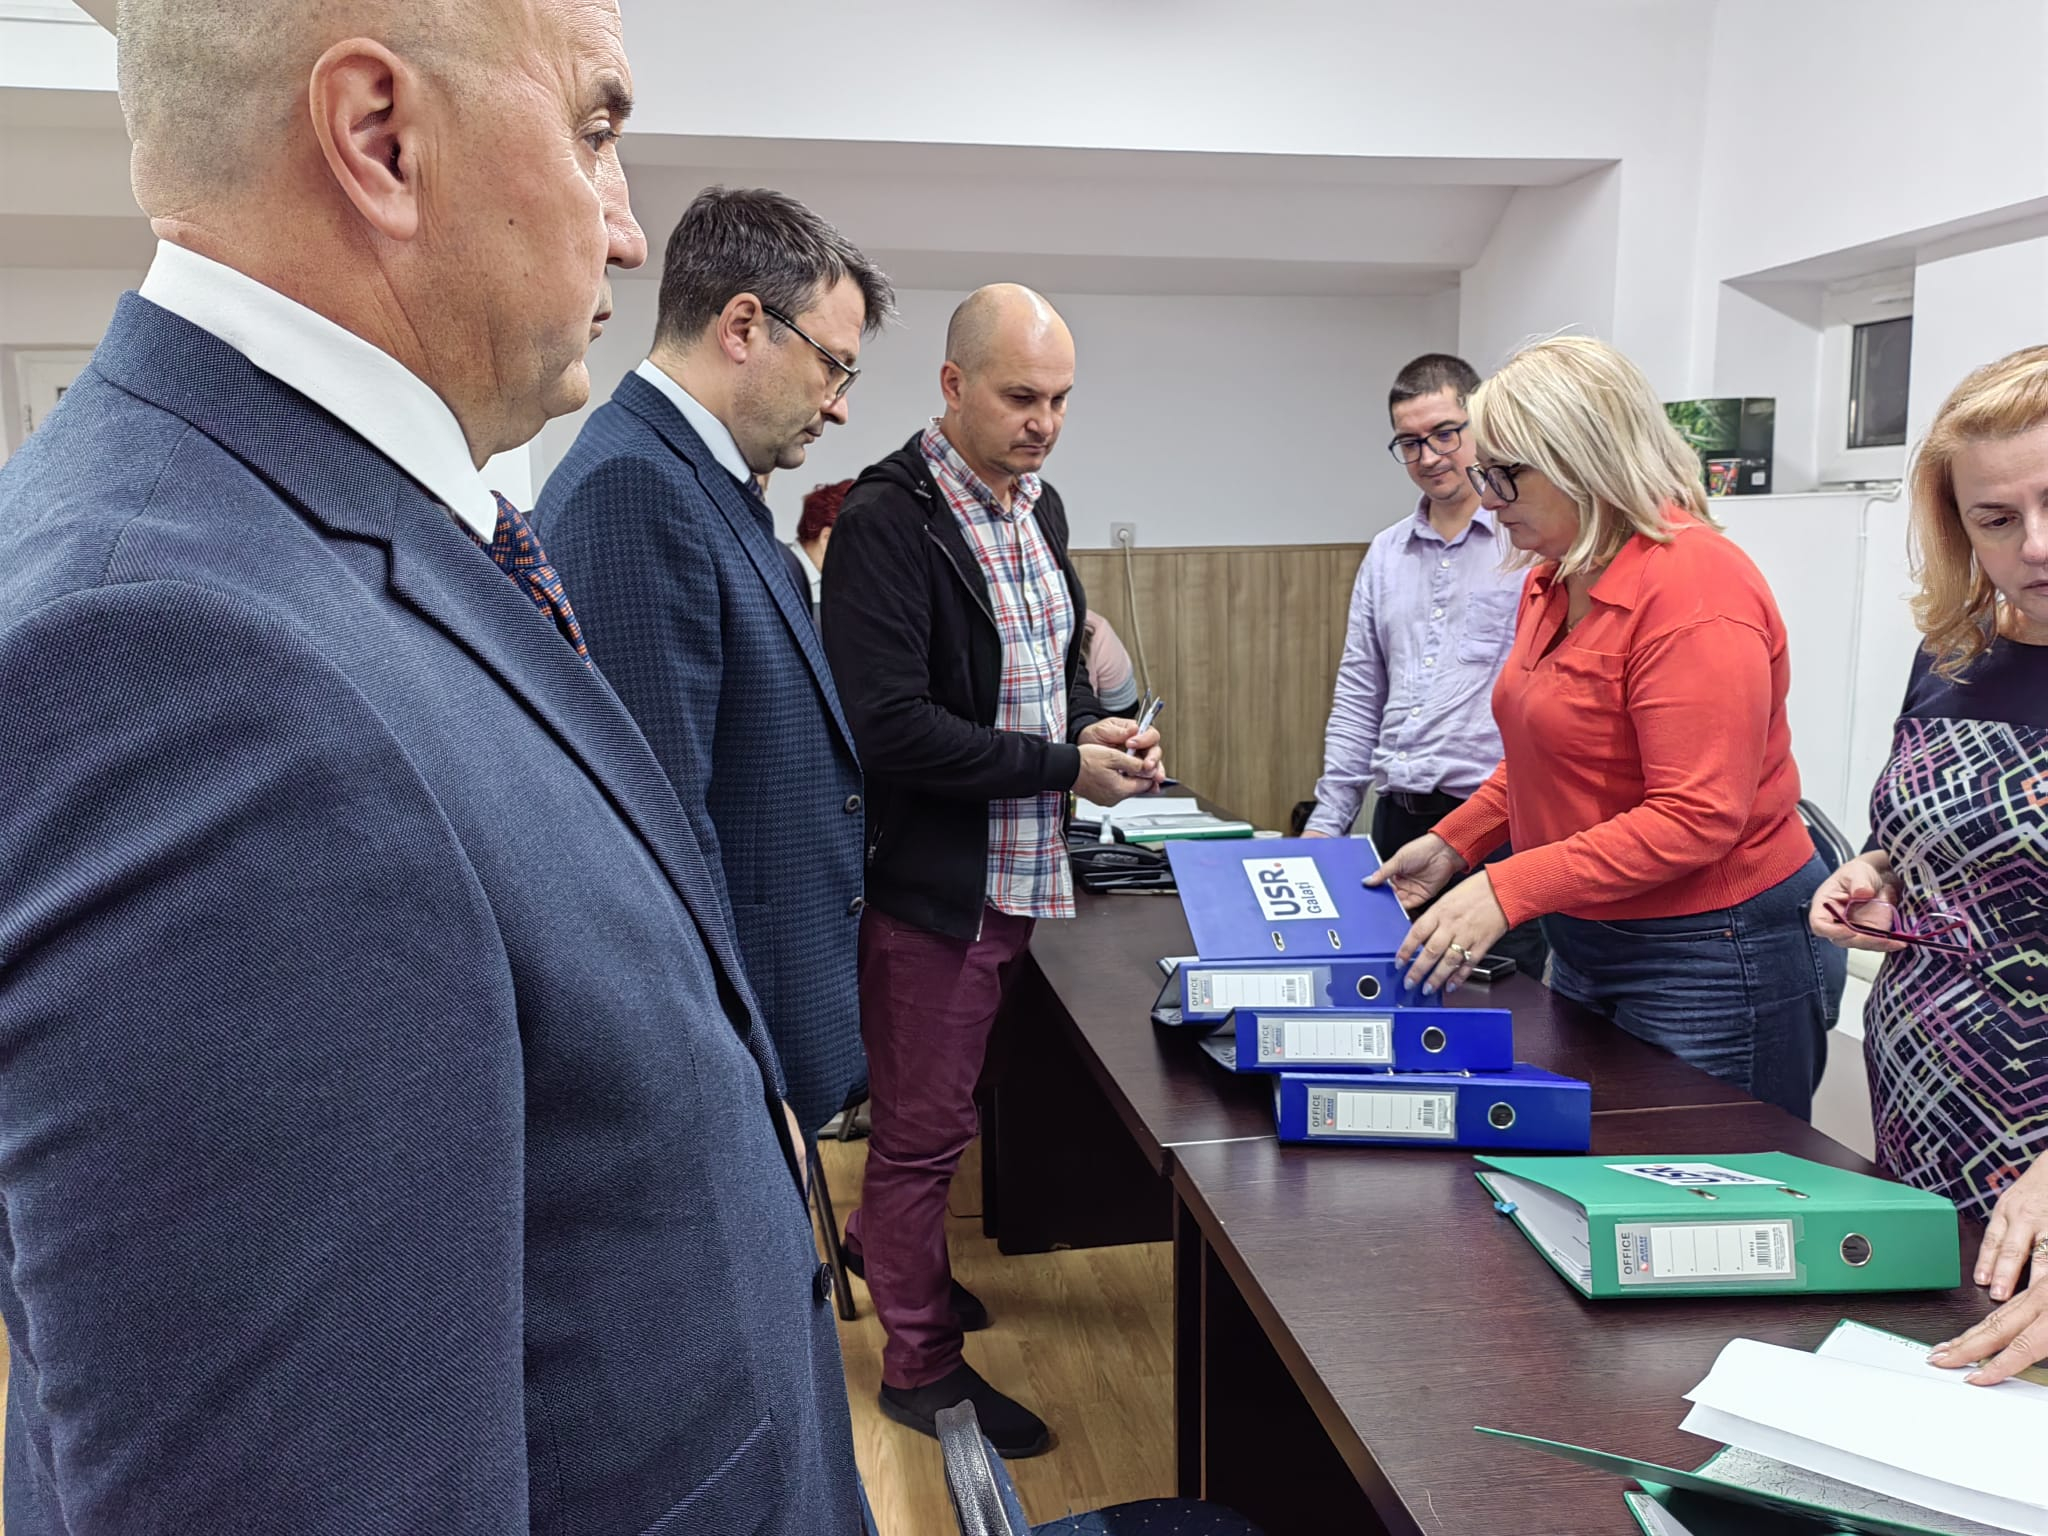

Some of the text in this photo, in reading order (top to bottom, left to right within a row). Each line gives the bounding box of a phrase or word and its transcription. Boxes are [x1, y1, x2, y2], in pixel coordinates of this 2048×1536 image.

[1191, 977, 1200, 1007] OFFICE
[1262, 1025, 1270, 1056] OFFICE
[1312, 1094, 1321, 1128] OFFICE
[1621, 1231, 1633, 1275] OFFICE
